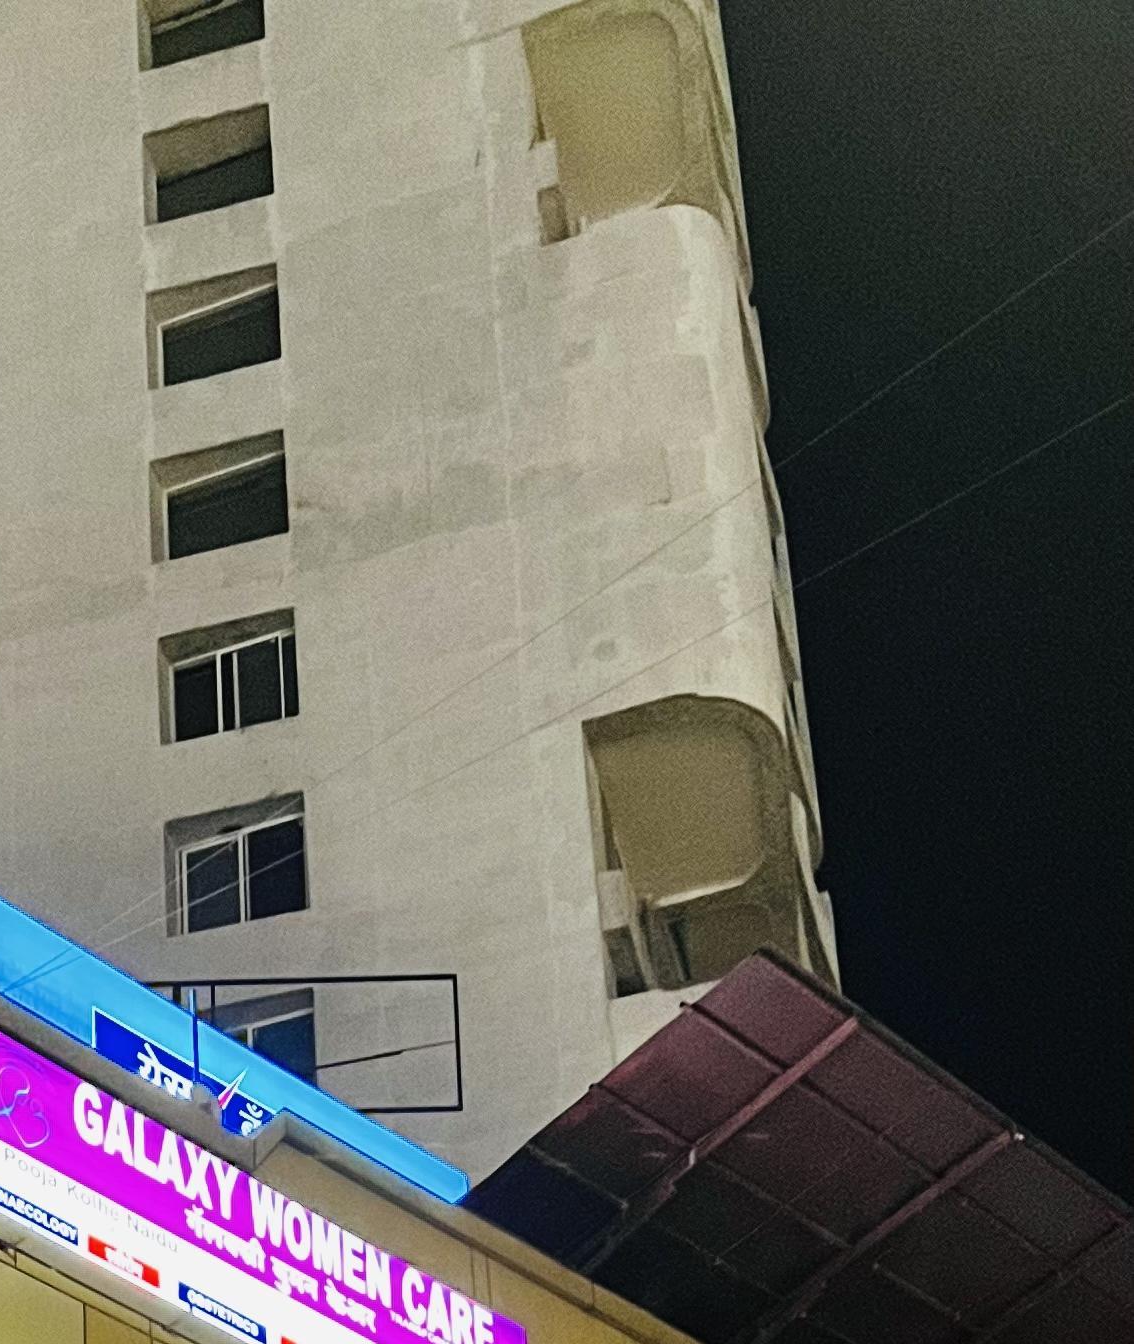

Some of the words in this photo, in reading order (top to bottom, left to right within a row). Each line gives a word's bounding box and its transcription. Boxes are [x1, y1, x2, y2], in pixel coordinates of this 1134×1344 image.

[4, 1148, 58, 1188] Pooja
[127, 1212, 178, 1253] Naidu
[73, 1081, 240, 1220] GALAXY
[249, 1175, 392, 1308] WOMEN
